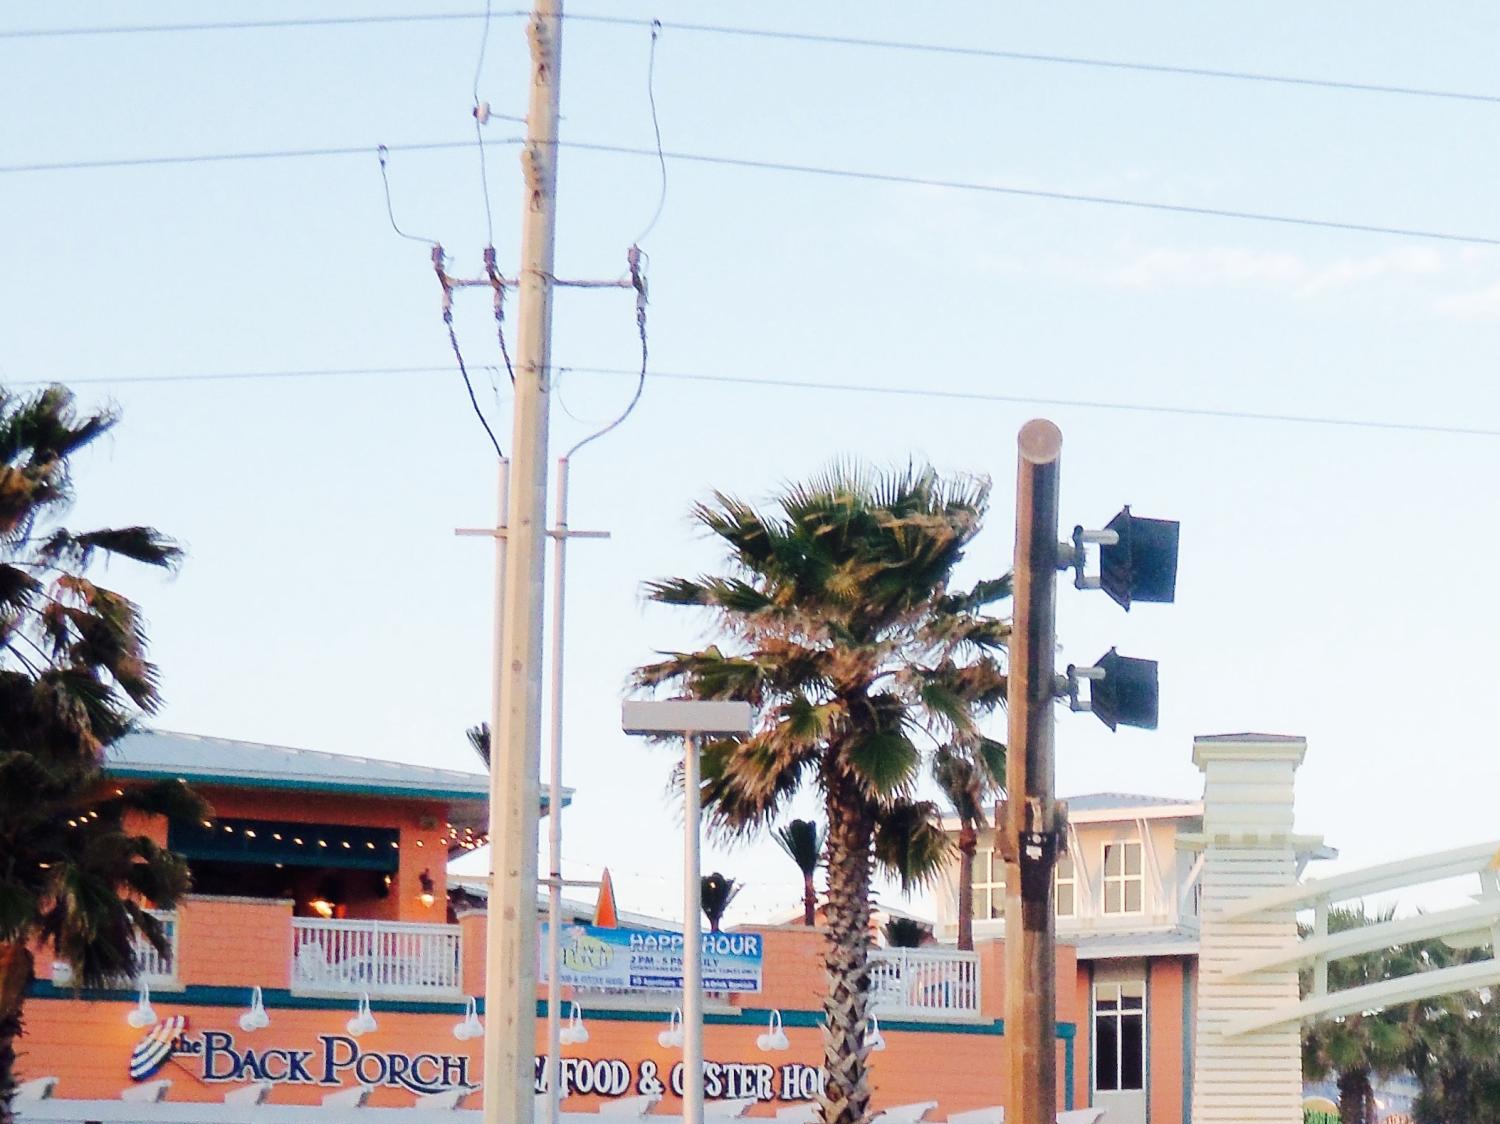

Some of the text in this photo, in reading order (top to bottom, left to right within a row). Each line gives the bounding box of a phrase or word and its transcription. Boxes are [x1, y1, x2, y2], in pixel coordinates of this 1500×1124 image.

[630, 932, 758, 957] HAPP HOUR
[171, 1030, 483, 1097] the BACK PORCH
[534, 1055, 632, 1097] EAFOOD
[638, 1058, 664, 1096] &
[672, 1059, 775, 1102] OSTER
